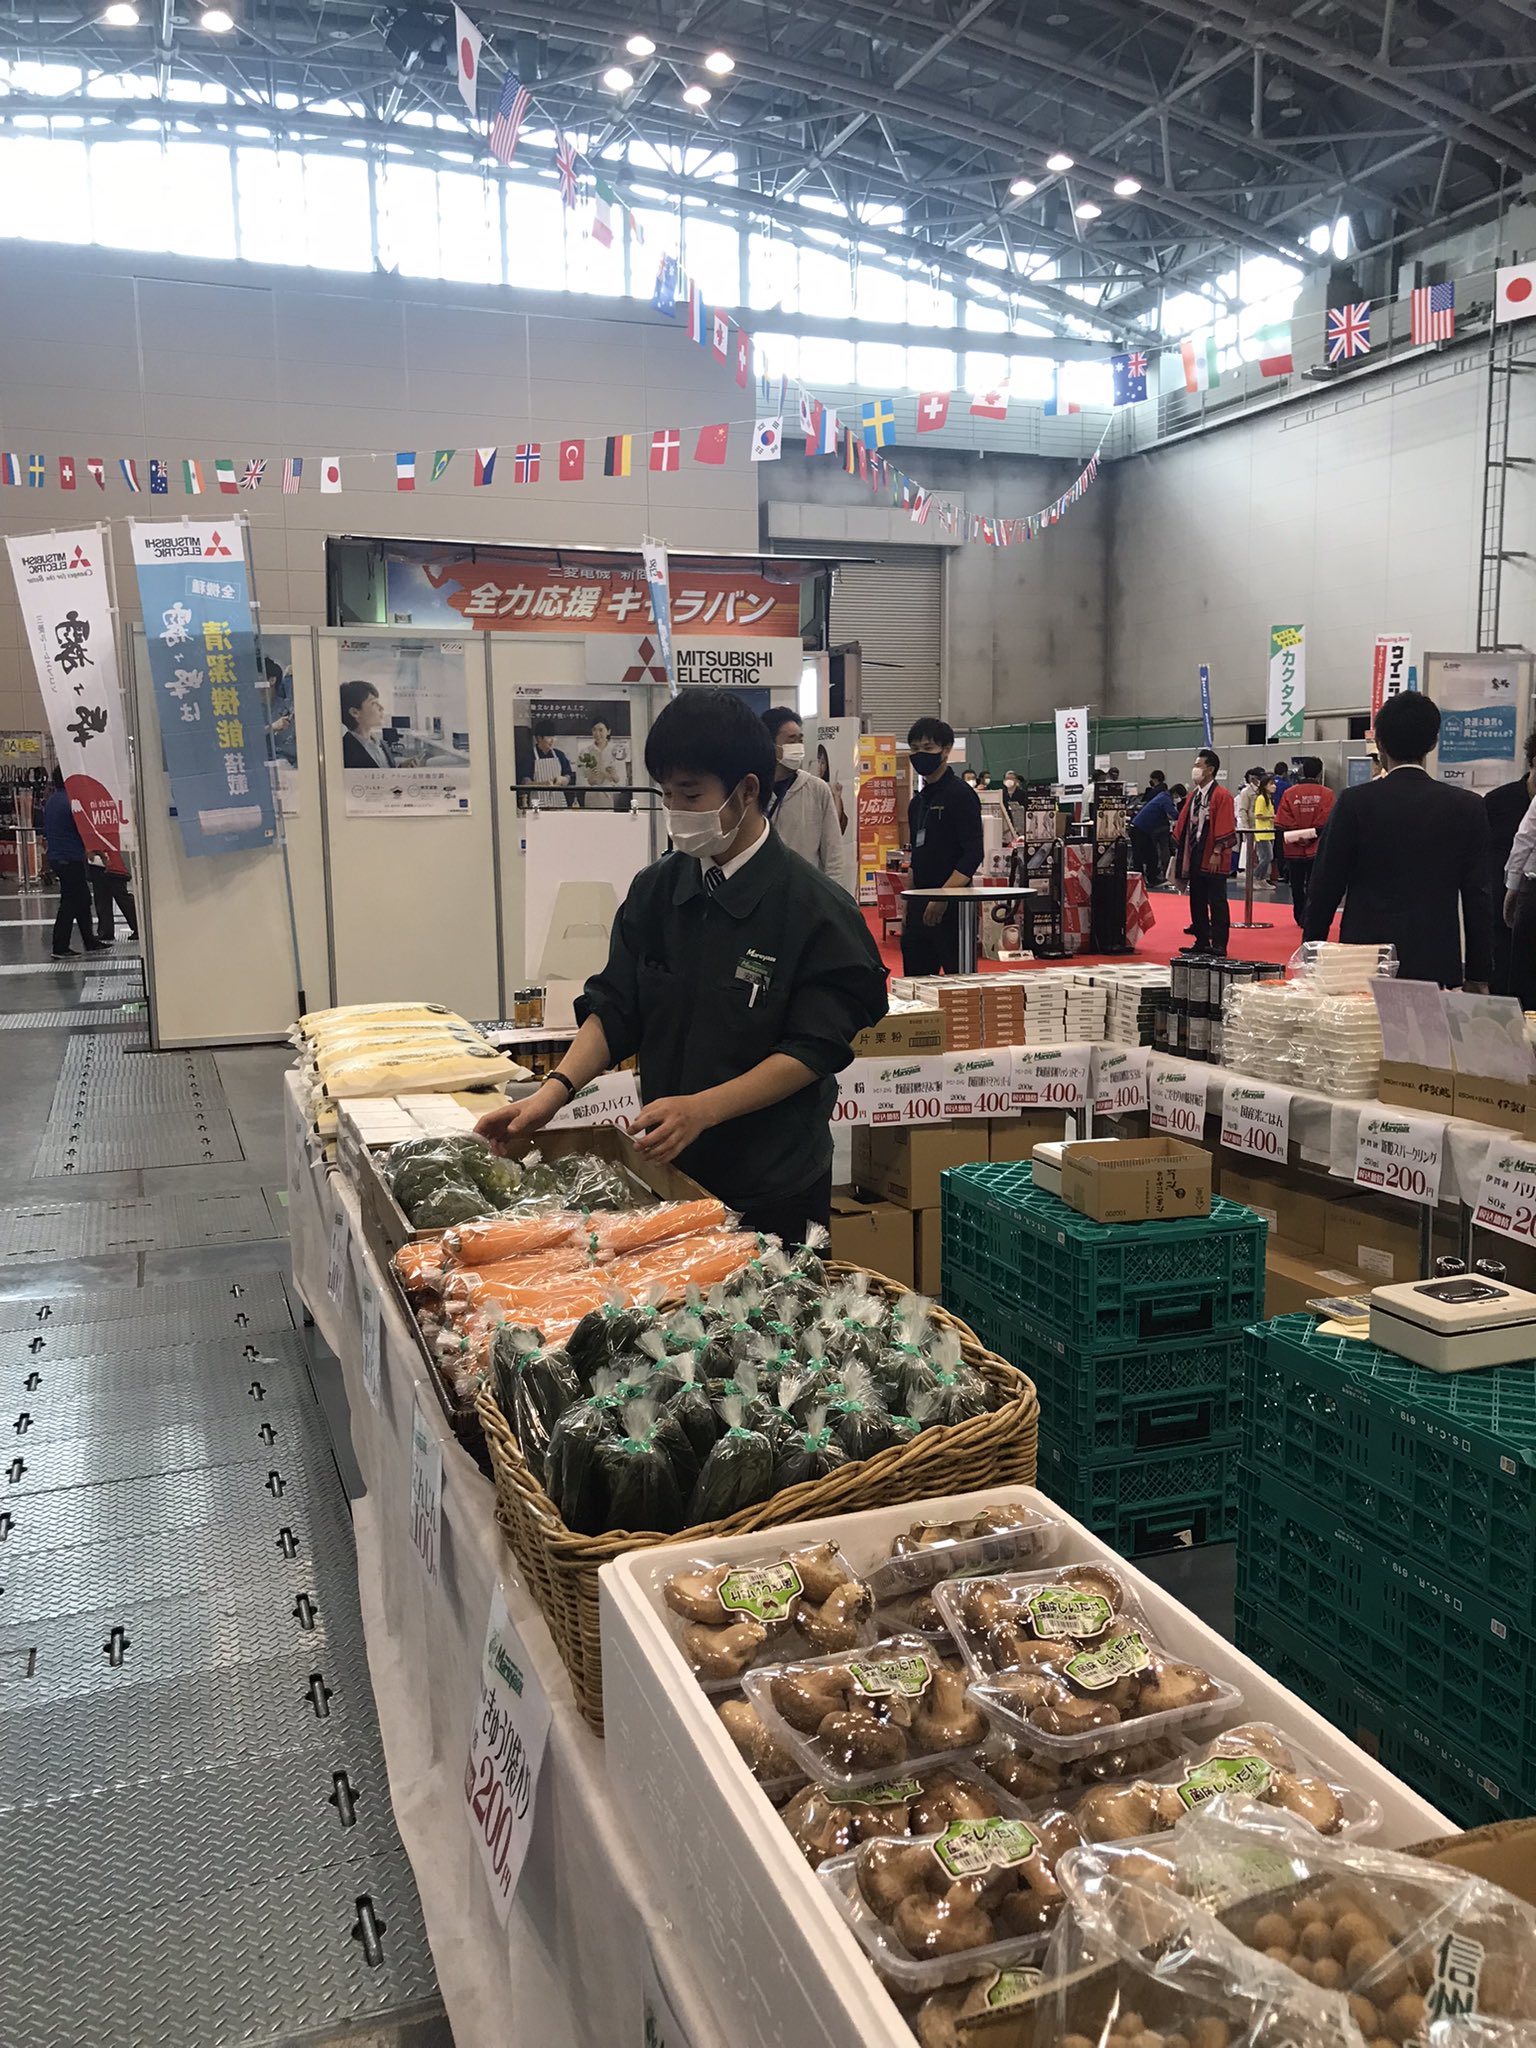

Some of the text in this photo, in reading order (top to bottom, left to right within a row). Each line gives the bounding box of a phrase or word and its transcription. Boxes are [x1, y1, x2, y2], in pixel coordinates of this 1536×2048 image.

[465, 582, 602, 620] 全力応援
[676, 650, 773, 668] MITSUBISHI
[676, 667, 760, 684] ELECTRIC
[1279, 650, 1296, 717] カクタス
[866, 780, 894, 789] 三菱電機
[860, 1031, 903, 1045] 片栗粉
[1040, 1083, 1084, 1103] 400円
[1114, 1085, 1145, 1107] 400円
[572, 1096, 634, 1119] 魔法のスパイス
[877, 1102, 894, 1110] 200g
[1240, 1105, 1284, 1128] 国産米ごはん
[1243, 1126, 1284, 1156] 400円
[1386, 1162, 1434, 1198] 200円
[1512, 1181, 1536, 1202] バリ
[1487, 1195, 1507, 1210] 80g
[1400, 1411, 1459, 1447] S.C.R. 619
[1392, 1562, 1451, 1604] S.C.R. 619
[1413, 1727, 1430, 1747] 619
[482, 1687, 532, 1820] きゅうり袋入り
[472, 1755, 513, 1898] 200円
[1428, 1933, 1485, 2021] 信州
